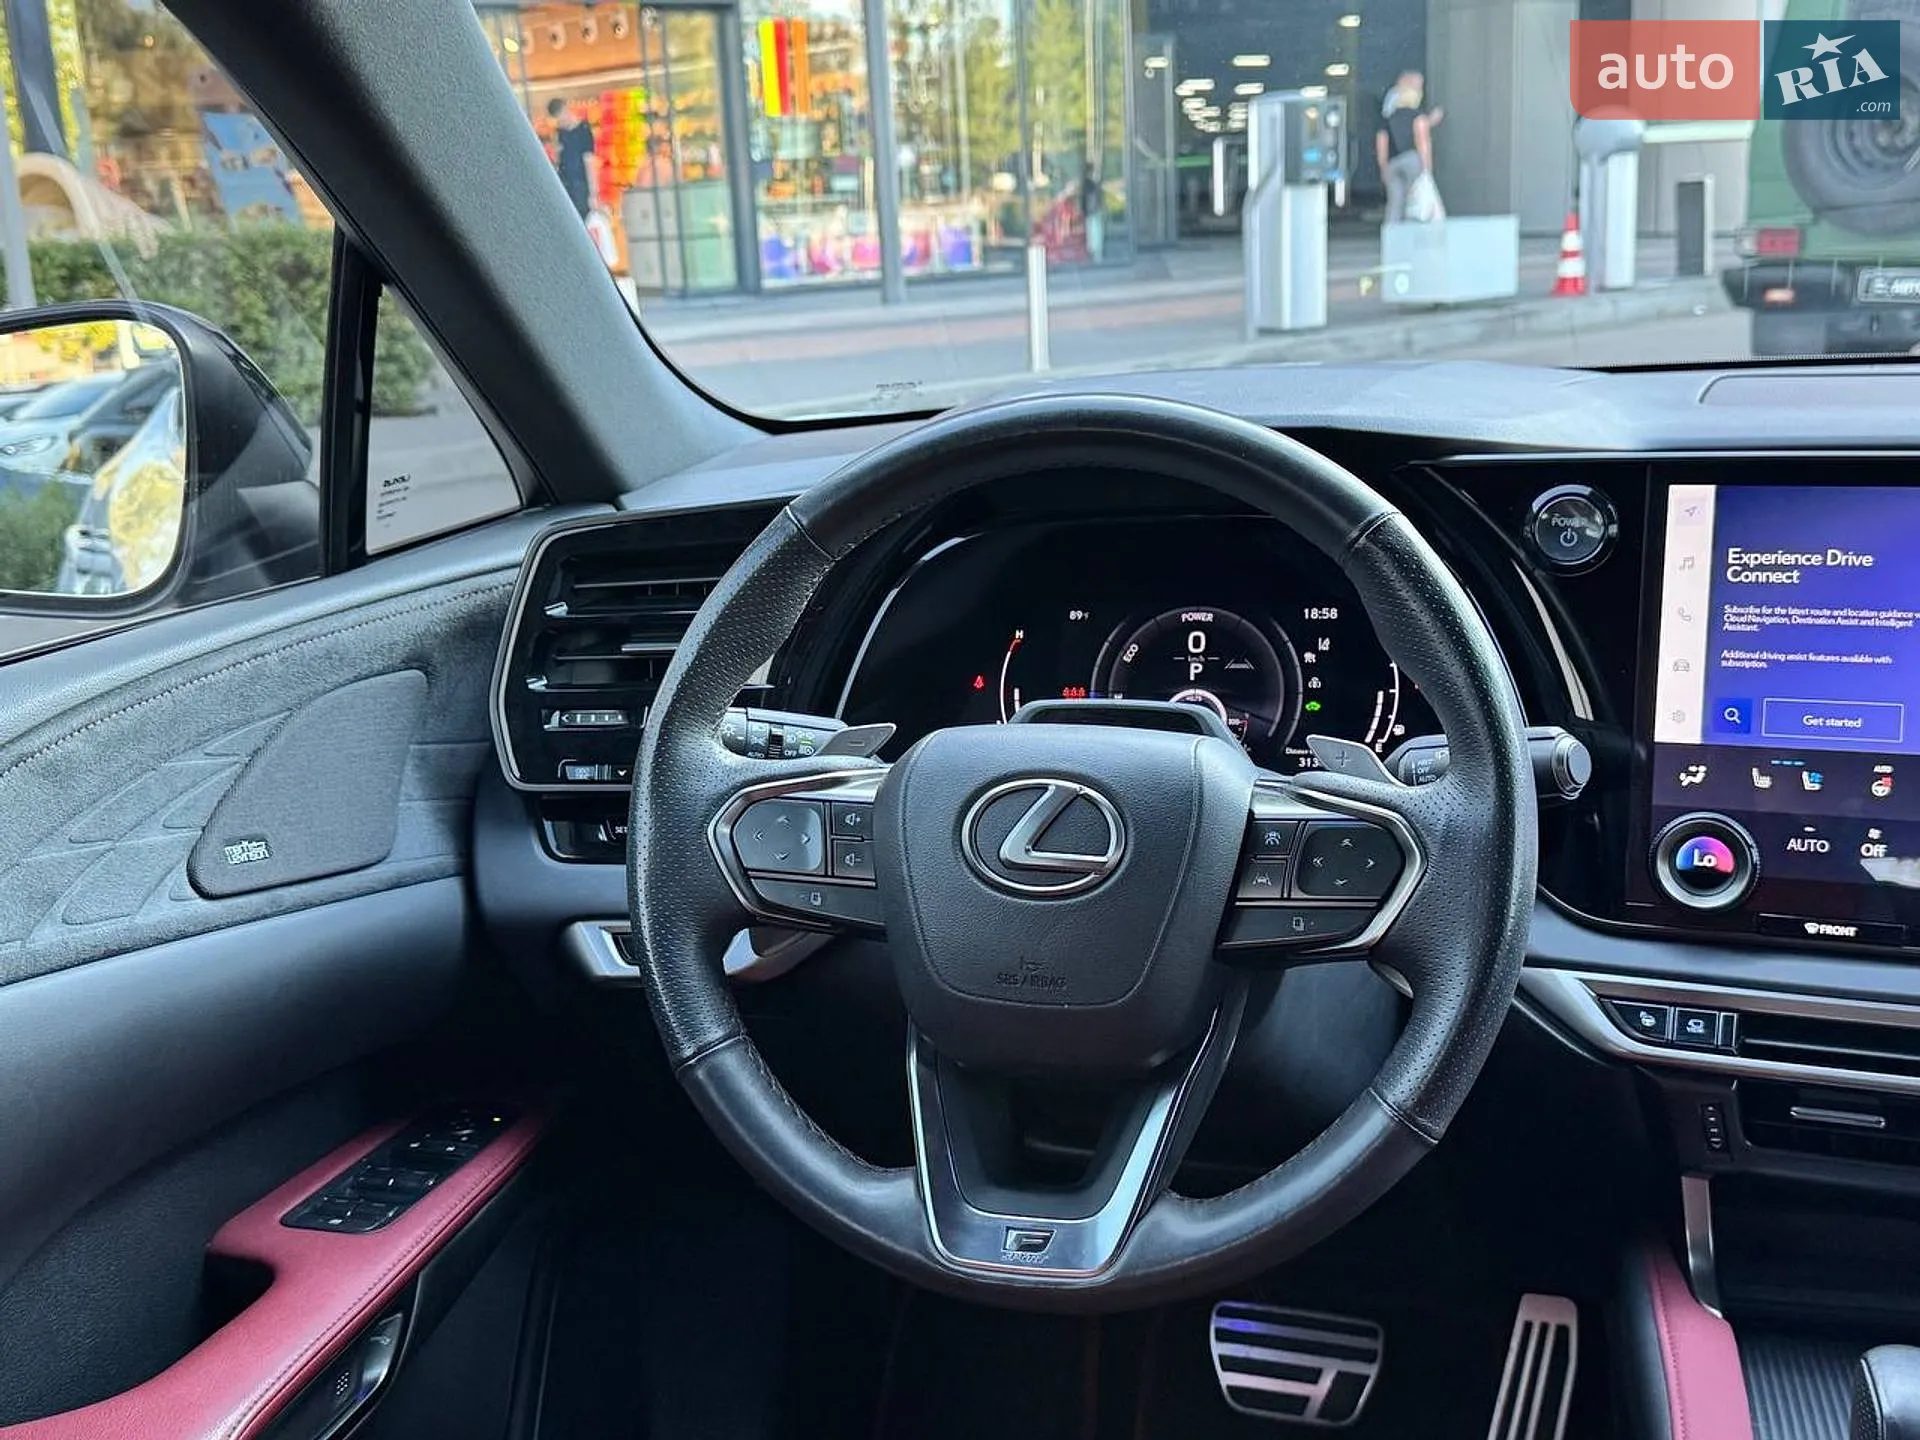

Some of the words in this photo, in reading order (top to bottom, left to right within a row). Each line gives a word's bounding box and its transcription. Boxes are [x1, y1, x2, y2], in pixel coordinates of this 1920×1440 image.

[1727, 548, 1822, 569] Experience
[1826, 549, 1874, 567] Drive
[1726, 567, 1800, 584] Connect
[1181, 612, 1213, 622] POWER
[1303, 608, 1338, 619] 18:58
[1724, 605, 1761, 615] Subscribe
[1762, 605, 1773, 615] for
[1774, 606, 1787, 616] the
[1833, 608, 1847, 617] and
[1848, 608, 1878, 618] location
[1880, 610, 1914, 620] guidance
[1724, 614, 1747, 623] Cloud
[1791, 615, 1835, 625] Destination
[1123, 643, 1139, 663] ECO
[1721, 650, 1760, 660] Additional
[1808, 653, 1840, 663] features
[1841, 655, 1873, 664] available
[1874, 656, 1892, 664] with
[1189, 663, 1203, 681] P
[1803, 715, 1824, 727] Get
[1825, 717, 1862, 728] started
[1299, 757, 1319, 768] 313
[1787, 839, 1830, 852] AUTO
[1861, 844, 1888, 857] Off
[1693, 849, 1717, 867] Lo
[1820, 924, 1858, 937] FRONT
